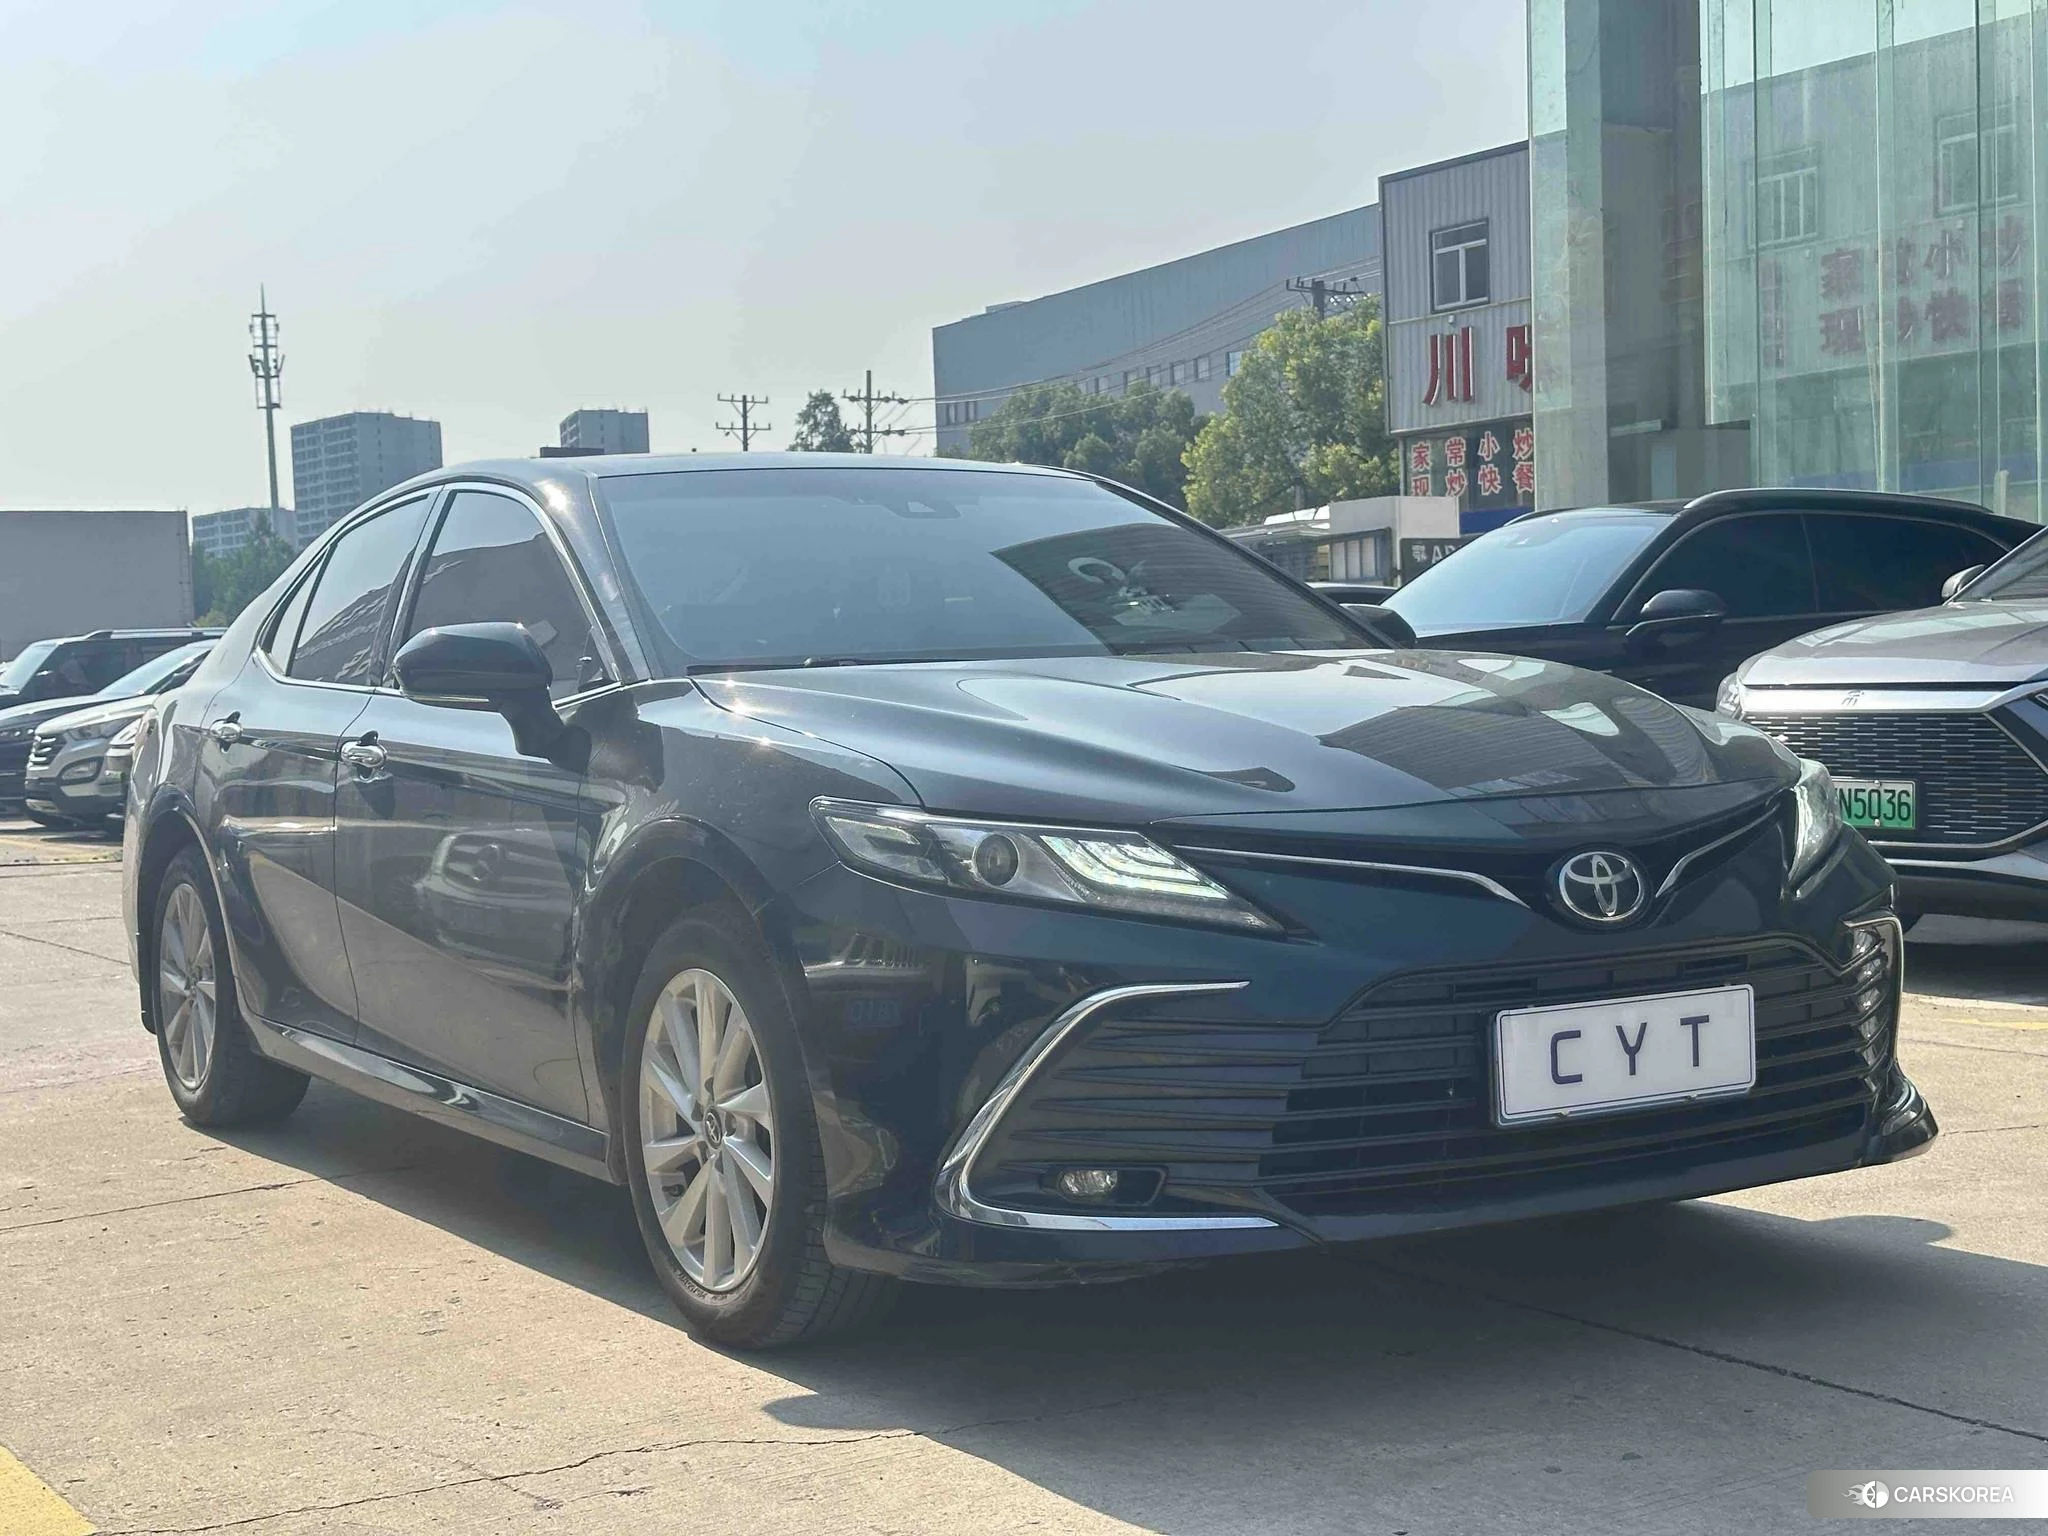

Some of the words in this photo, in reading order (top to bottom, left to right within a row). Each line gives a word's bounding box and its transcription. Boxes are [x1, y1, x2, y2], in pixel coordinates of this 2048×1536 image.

[1411, 428, 1534, 471] 家常小炒
[1411, 461, 1534, 497] 现炒快餐
[1835, 787, 1911, 821] N5036
